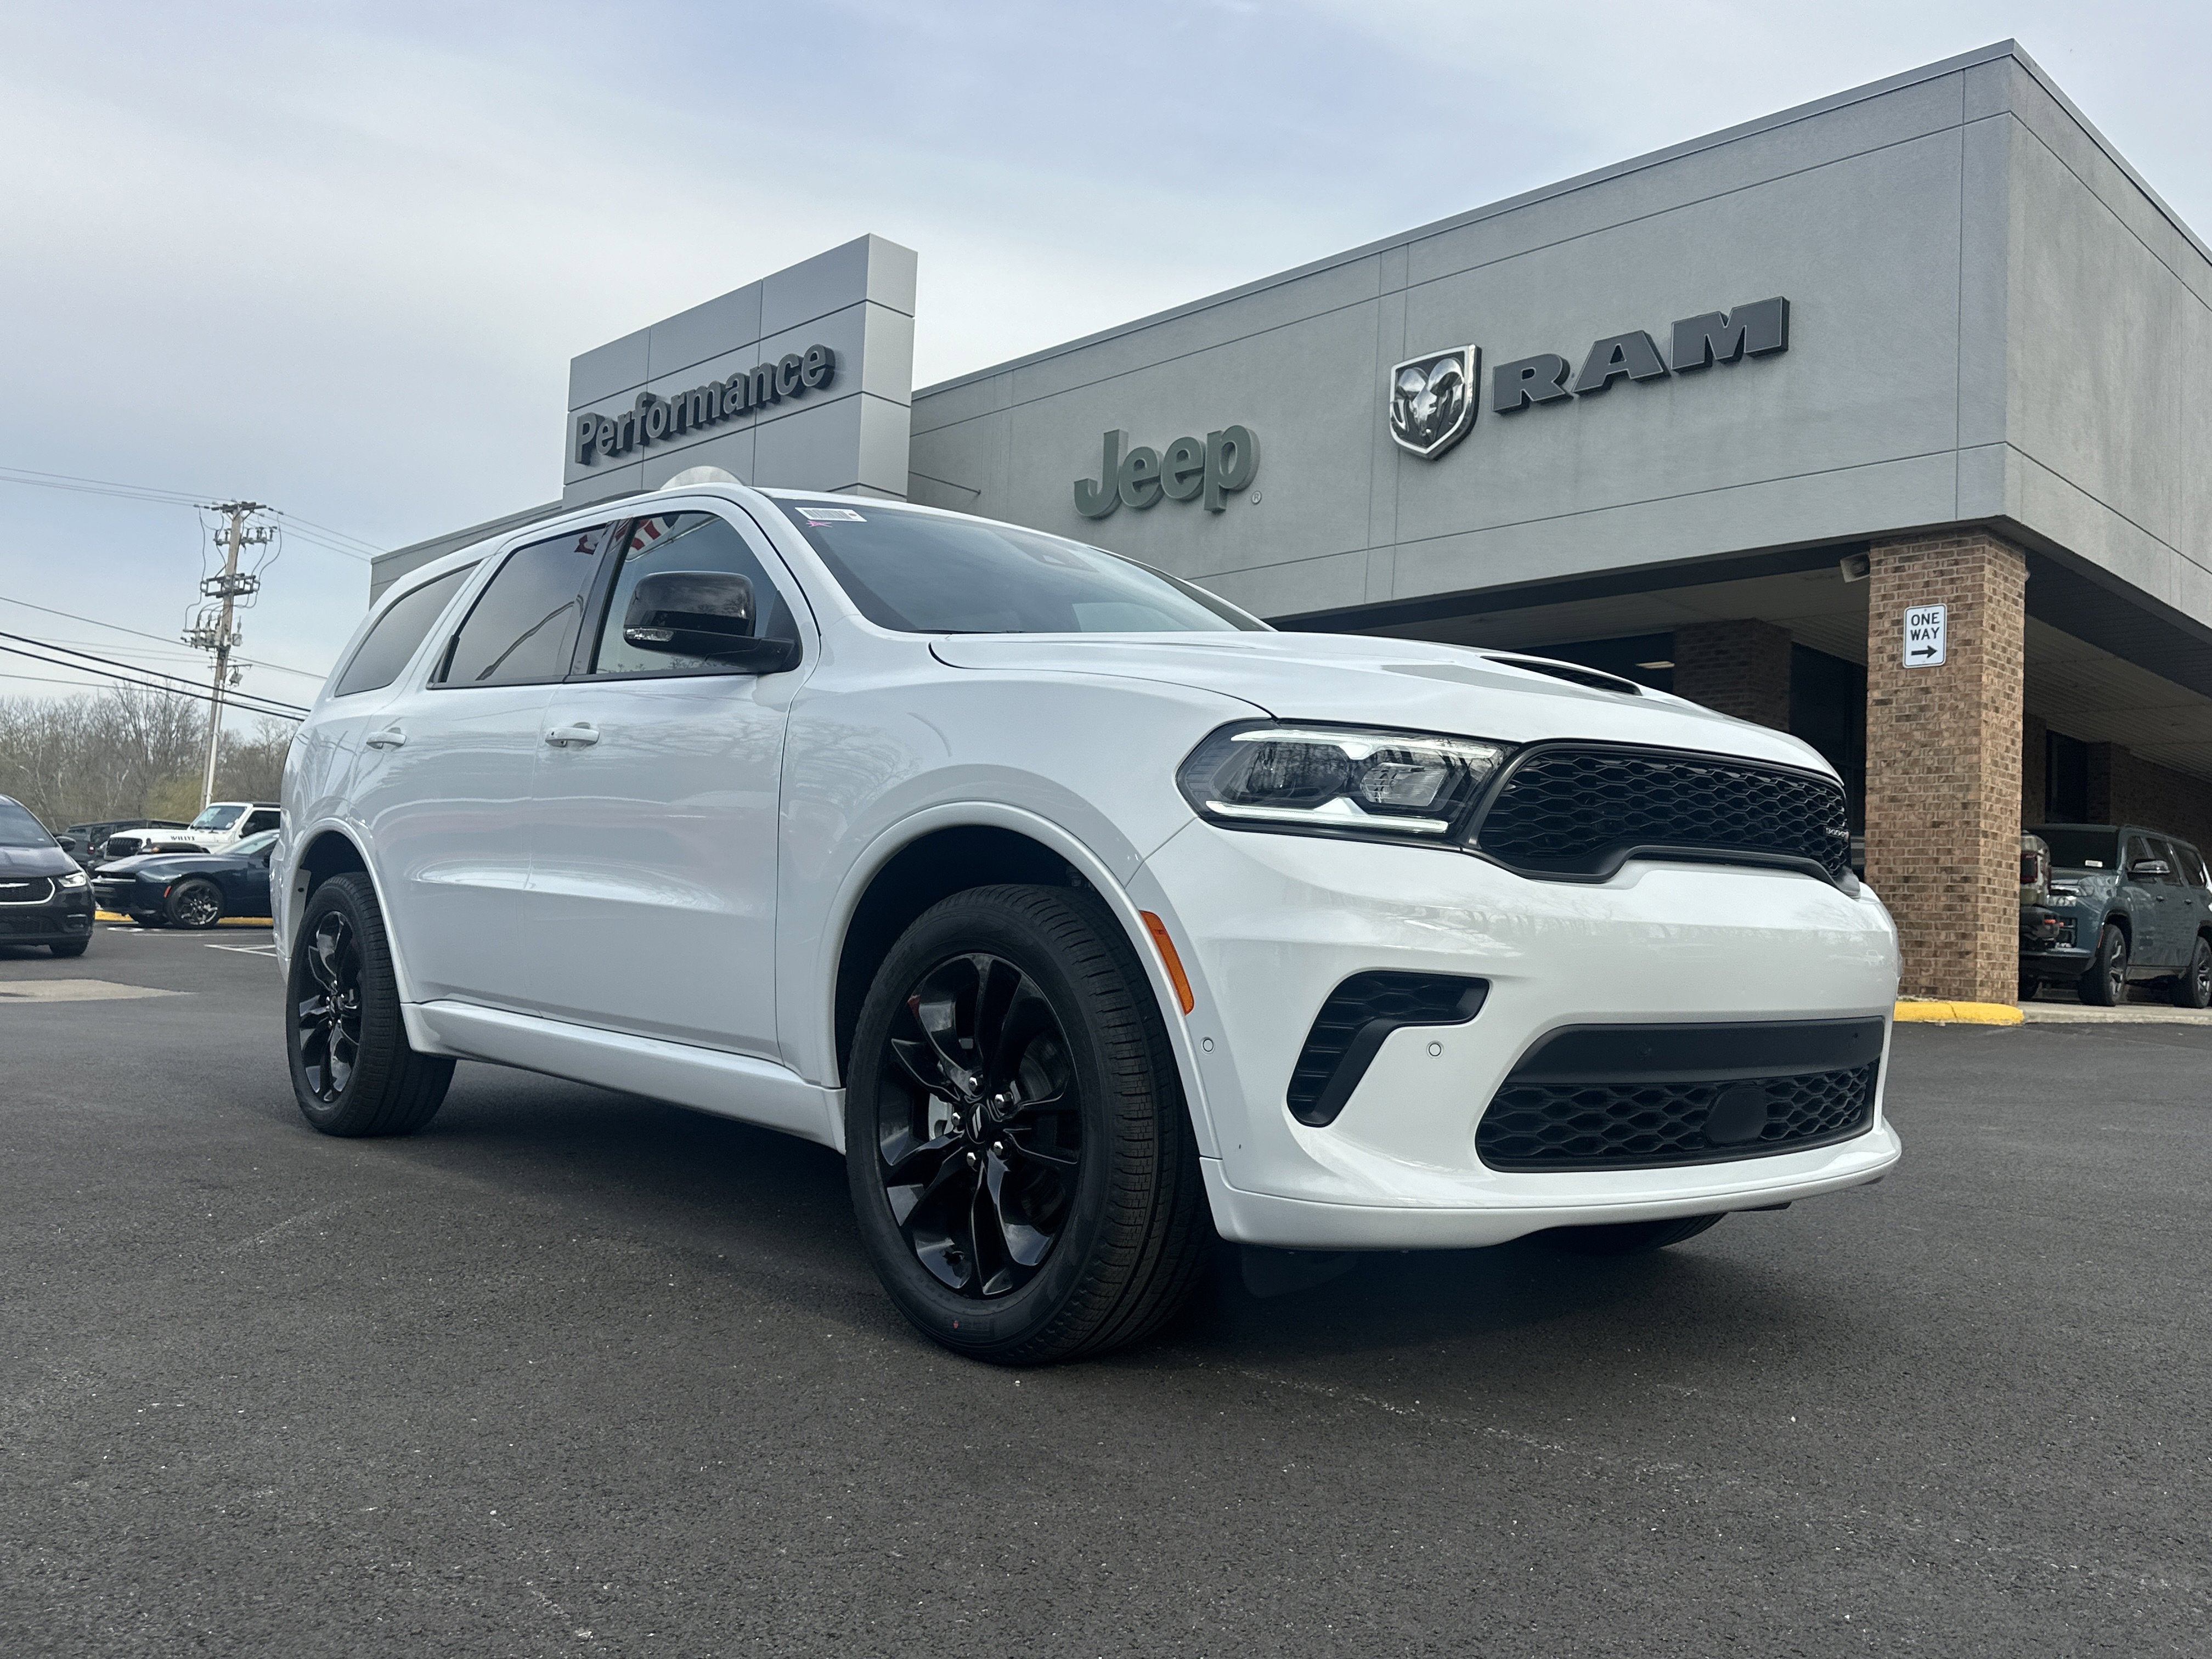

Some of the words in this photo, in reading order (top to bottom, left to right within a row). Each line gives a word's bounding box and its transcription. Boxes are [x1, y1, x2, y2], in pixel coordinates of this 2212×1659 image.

[1491, 296, 1790, 414] RAM
[575, 343, 836, 465] Performance
[1073, 424, 1261, 518] Jeep
[1910, 627, 1940, 641] WAY
[1911, 612, 1940, 626] ONE
